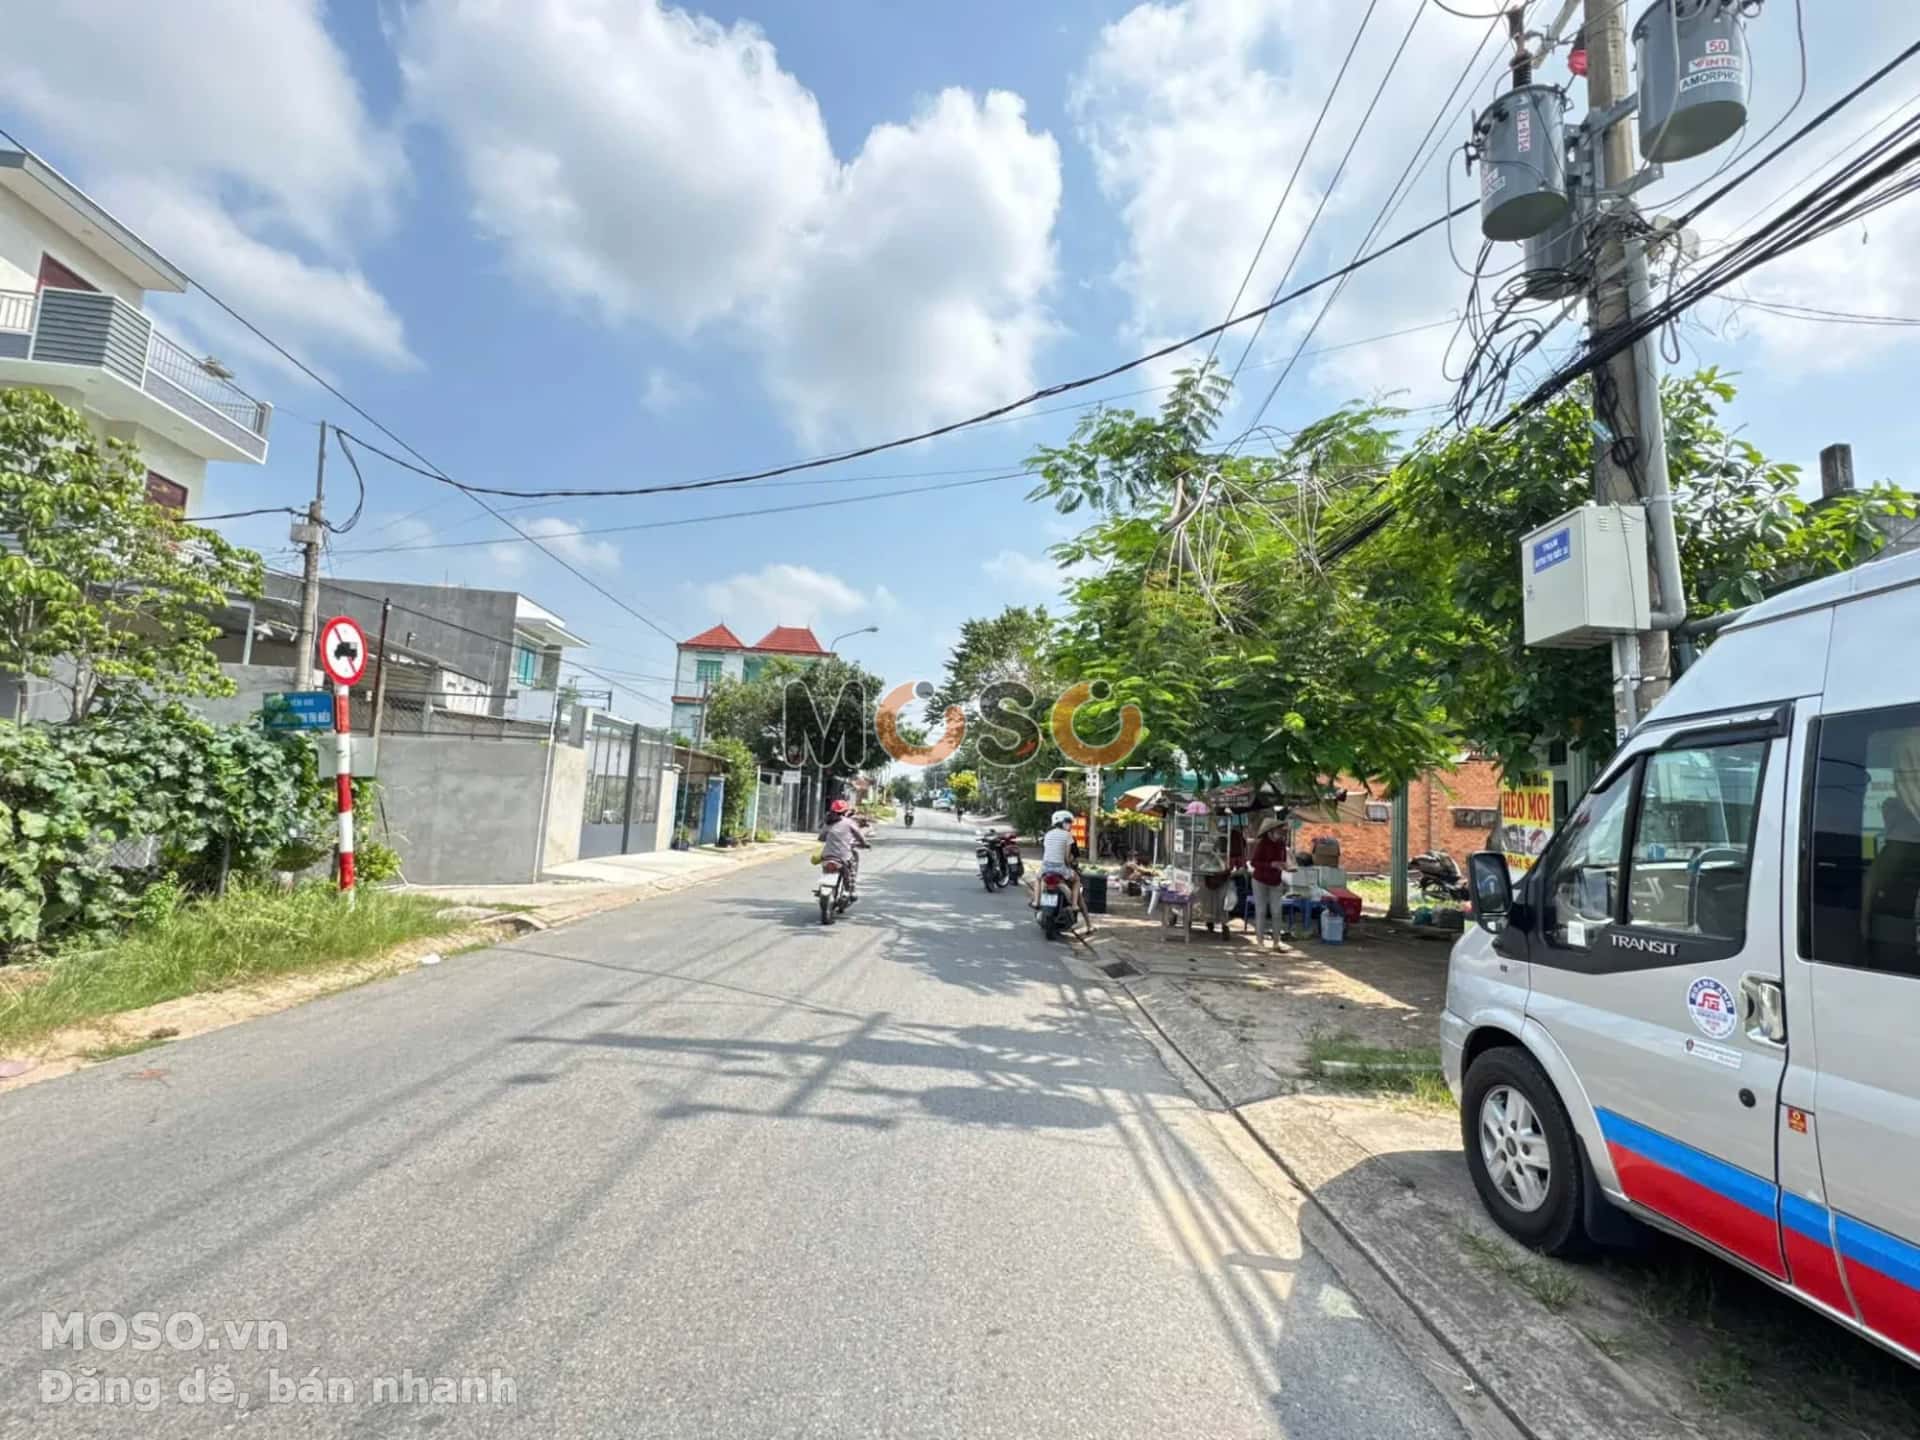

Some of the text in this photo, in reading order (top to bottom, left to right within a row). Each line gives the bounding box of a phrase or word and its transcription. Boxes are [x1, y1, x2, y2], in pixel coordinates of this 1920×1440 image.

[1709, 40, 1727, 51] 50
[1503, 791, 1551, 827] HEO MỌI
[1609, 934, 1681, 956] TRANSIT
